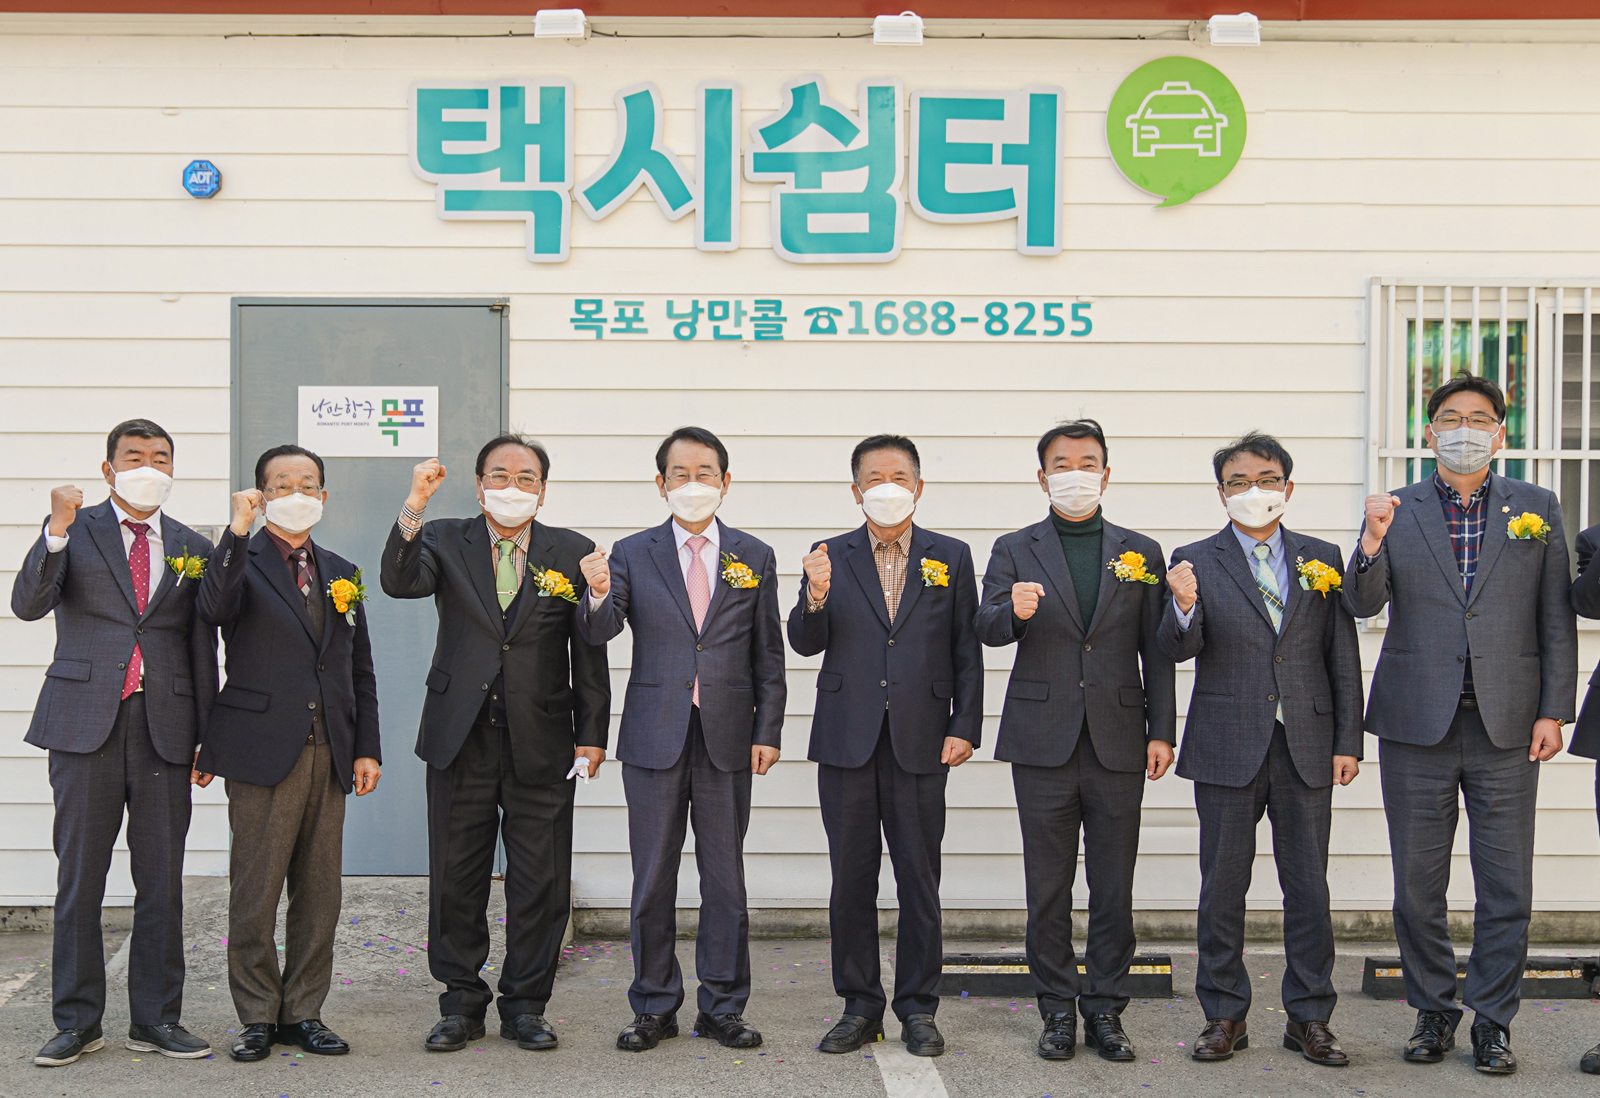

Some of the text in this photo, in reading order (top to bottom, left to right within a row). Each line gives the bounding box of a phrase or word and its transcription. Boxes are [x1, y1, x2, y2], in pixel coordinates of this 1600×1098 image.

[189, 171, 213, 184] ADT
[415, 81, 1059, 255] 택시쉼터
[569, 299, 1093, 341] 목포 낭만콜 1688-8255
[378, 399, 425, 446] 목포
